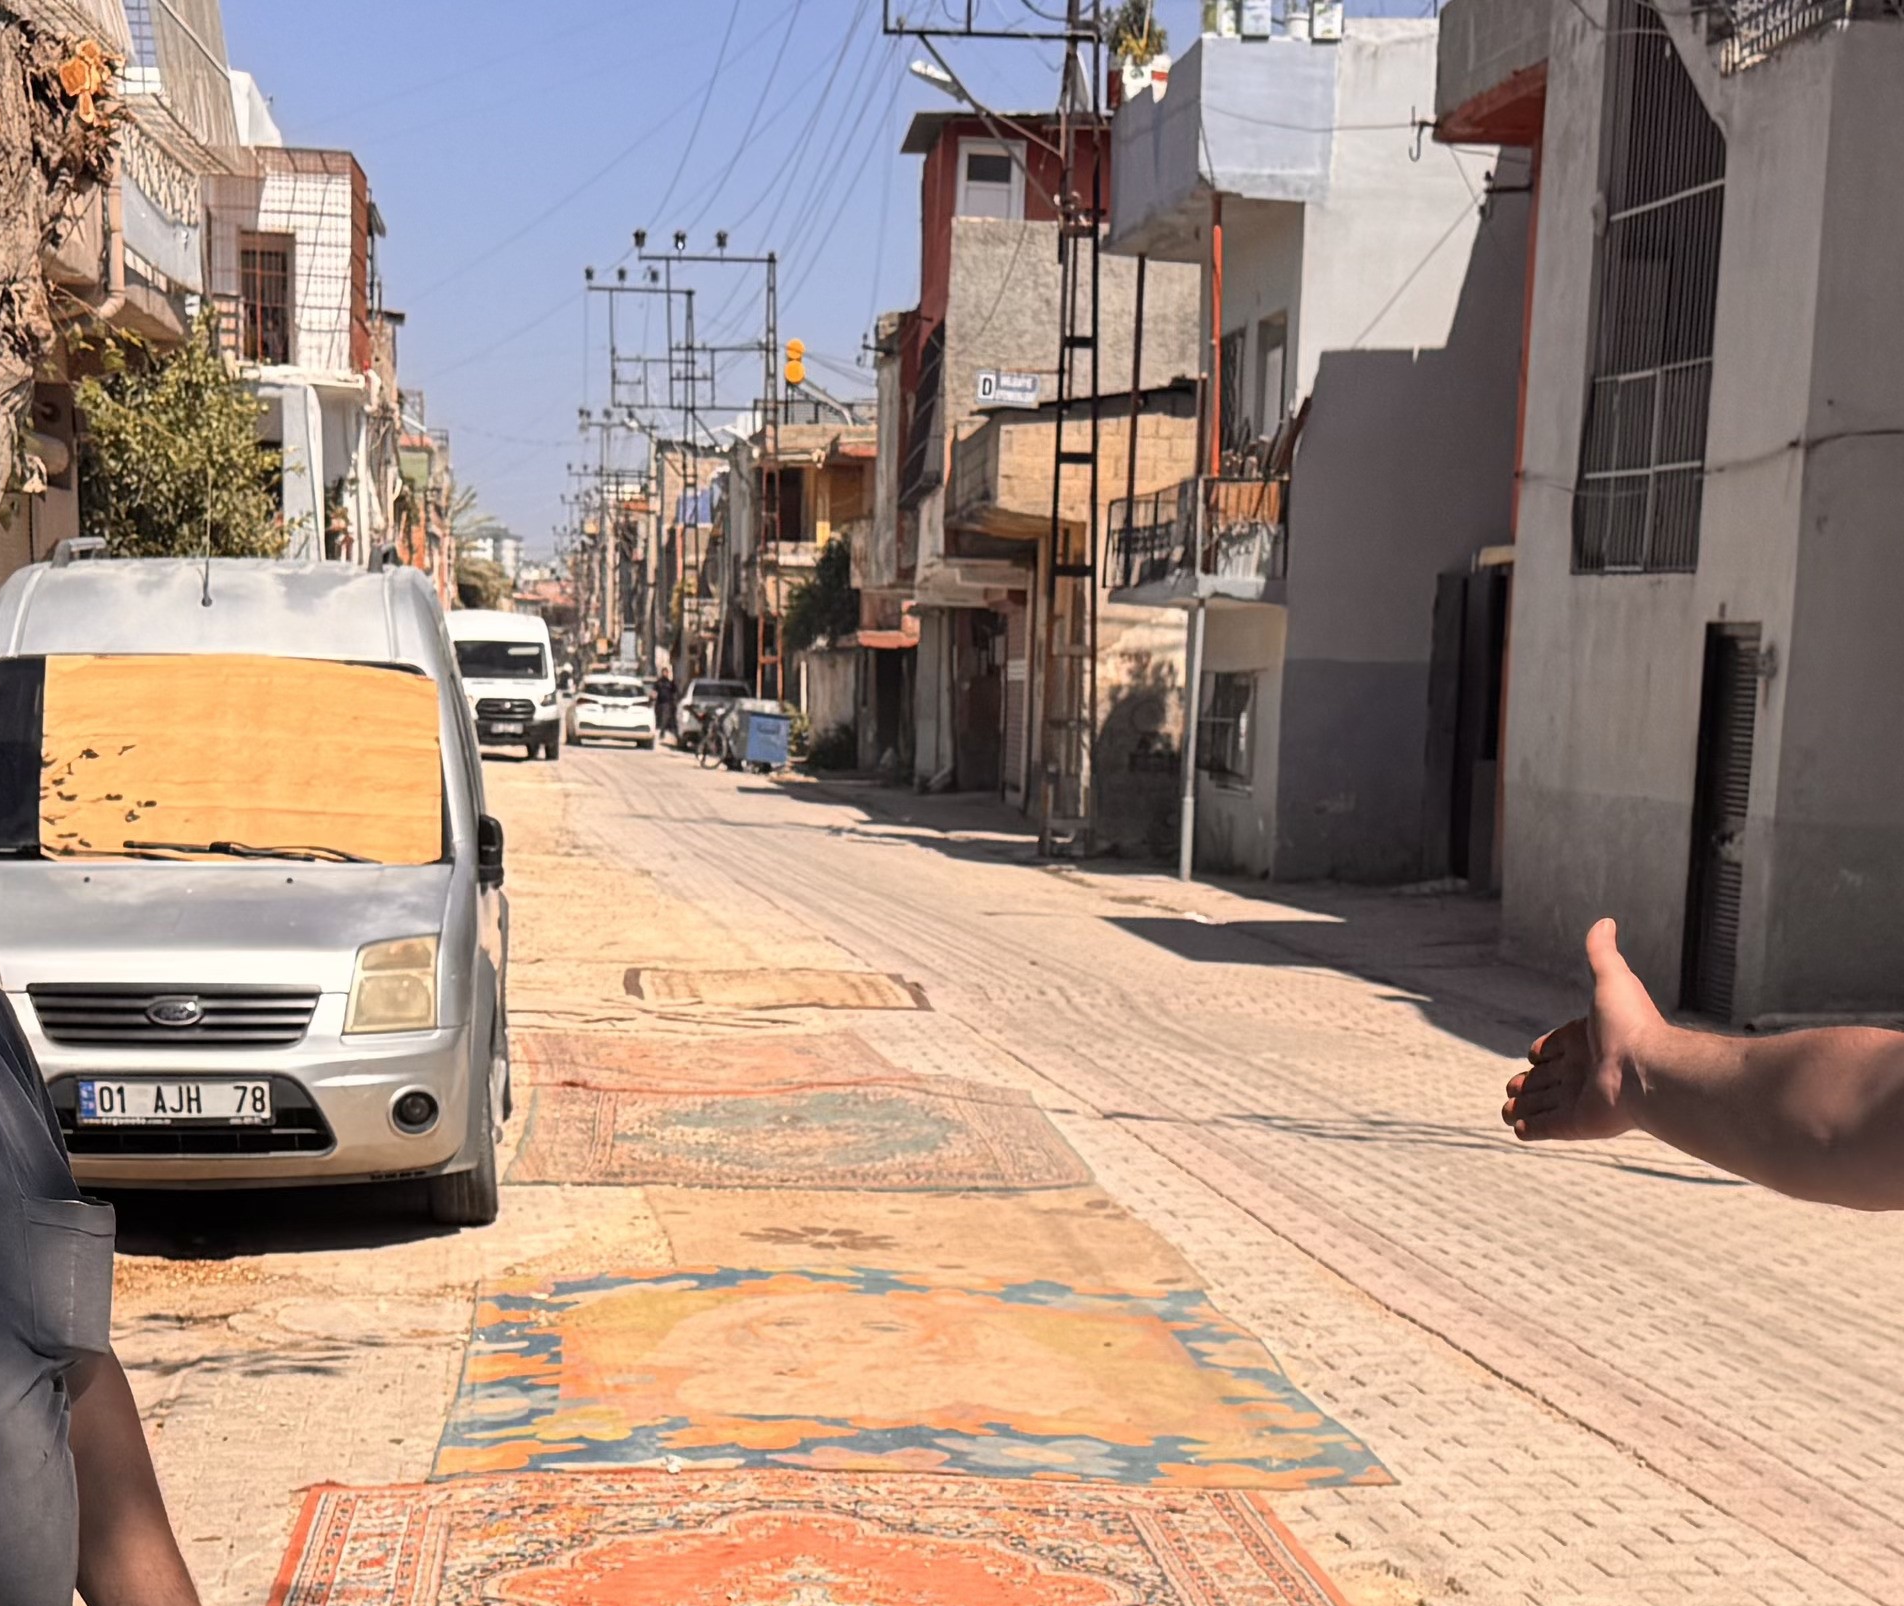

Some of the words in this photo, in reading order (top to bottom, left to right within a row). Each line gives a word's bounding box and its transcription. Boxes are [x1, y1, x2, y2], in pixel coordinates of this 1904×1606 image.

[99, 1086, 126, 1114] 01
[154, 1085, 202, 1114] AJH
[233, 1085, 266, 1114] 78
